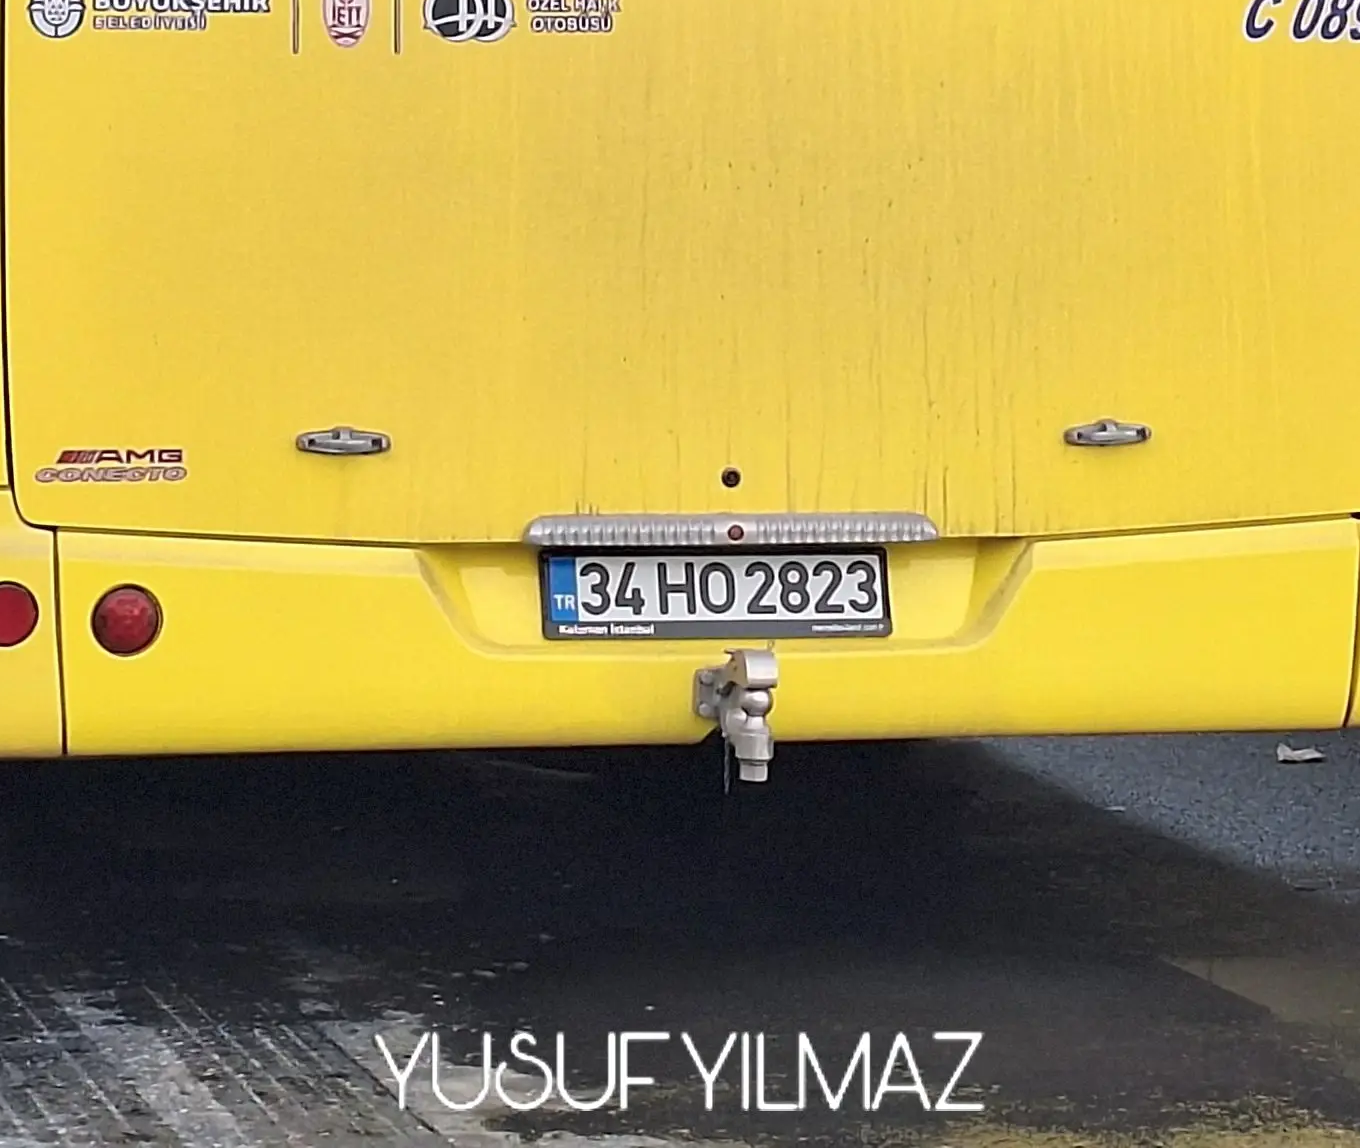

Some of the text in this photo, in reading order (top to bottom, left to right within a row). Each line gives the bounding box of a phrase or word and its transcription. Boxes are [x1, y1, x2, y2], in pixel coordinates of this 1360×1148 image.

[94, 449, 183, 464] AMG
[35, 466, 188, 483] CONECTO
[580, 560, 879, 616] 34 HO 2823
[553, 594, 576, 611] TR
